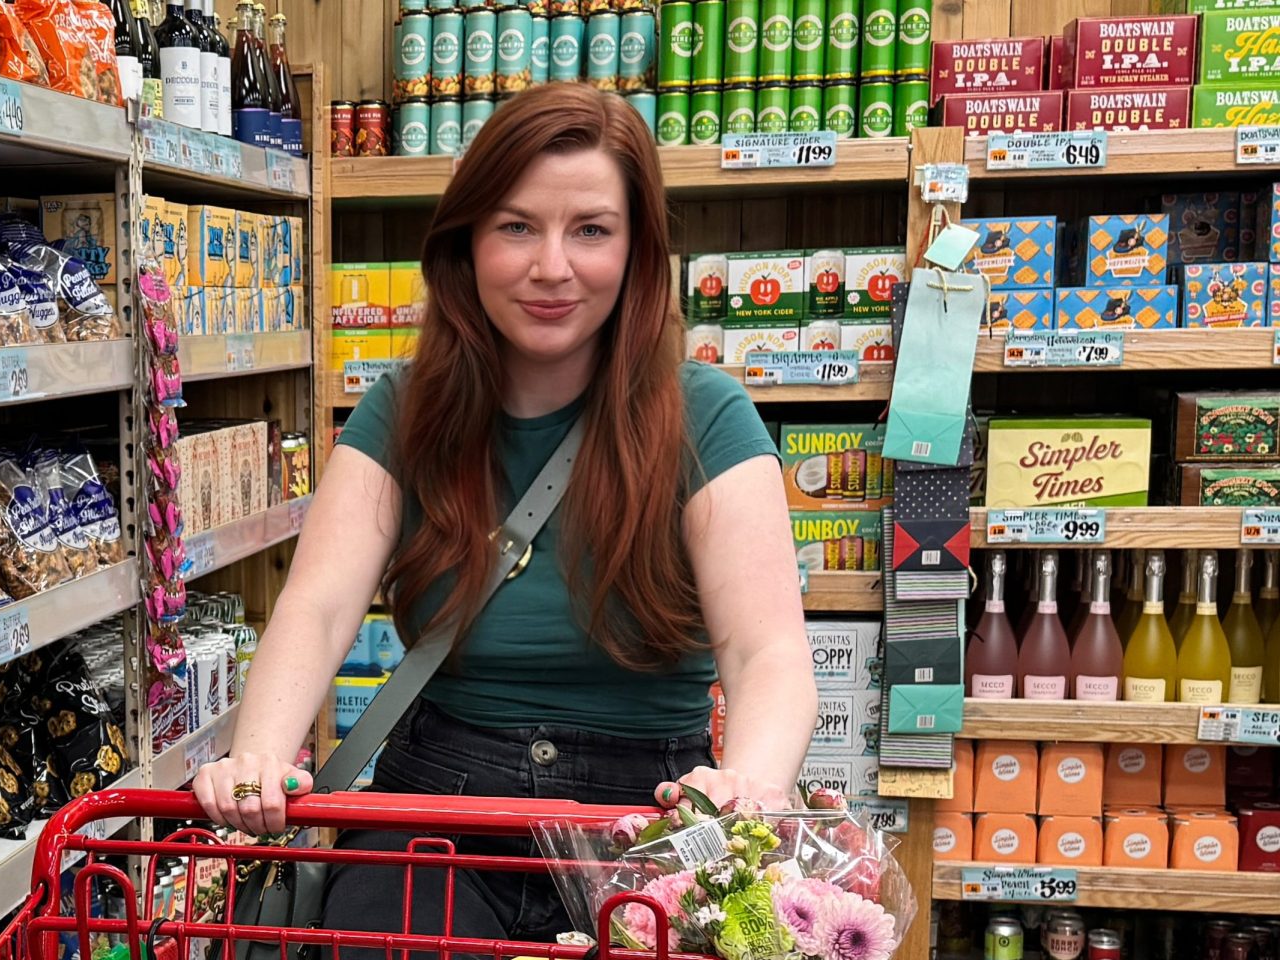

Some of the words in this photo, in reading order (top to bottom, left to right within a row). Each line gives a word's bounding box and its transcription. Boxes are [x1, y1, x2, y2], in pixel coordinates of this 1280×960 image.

[1099, 22, 1174, 37] BOATSWAIN
[953, 42, 1022, 58] BOATSWAIN
[1101, 38, 1171, 53] DOUBLE
[954, 57, 1020, 71] DOUBLE
[1102, 54, 1168, 69] I.P.A.
[955, 72, 1017, 87] I.P.A.
[966, 98, 1040, 114] BOATSWAIN
[1090, 94, 1167, 109] BOATSWAIN
[968, 114, 1038, 129] DOUBLE
[1092, 110, 1164, 124] DOUBLE
[735, 137, 789, 147] SIGNATURE
[794, 136, 820, 146] CIDER
[1008, 140, 1051, 149] DOUBLE
[1056, 138, 1071, 147] IPA
[1062, 144, 1100, 164] $6.49
[739, 262, 769, 291] HUDSON
[772, 262, 793, 290] NORTH
[856, 258, 886, 288] HUDSON
[332, 307, 383, 316] NFILTERED
[333, 316, 354, 324] AFT
[357, 316, 388, 324] CIDER
[2, 357, 20, 370] BUTTER
[786, 432, 863, 454] SUNBOY
[1020, 436, 1123, 471] Simpler
[1032, 472, 1104, 500] Times
[1002, 511, 1048, 522] SIMPLER
[1055, 511, 1087, 521] TIMES
[3, 614, 21, 629] BUTTER
[1033, 682, 1056, 690] SECCO
[1085, 682, 1109, 690] SECCO
[802, 766, 845, 777] LAGUNITAS
